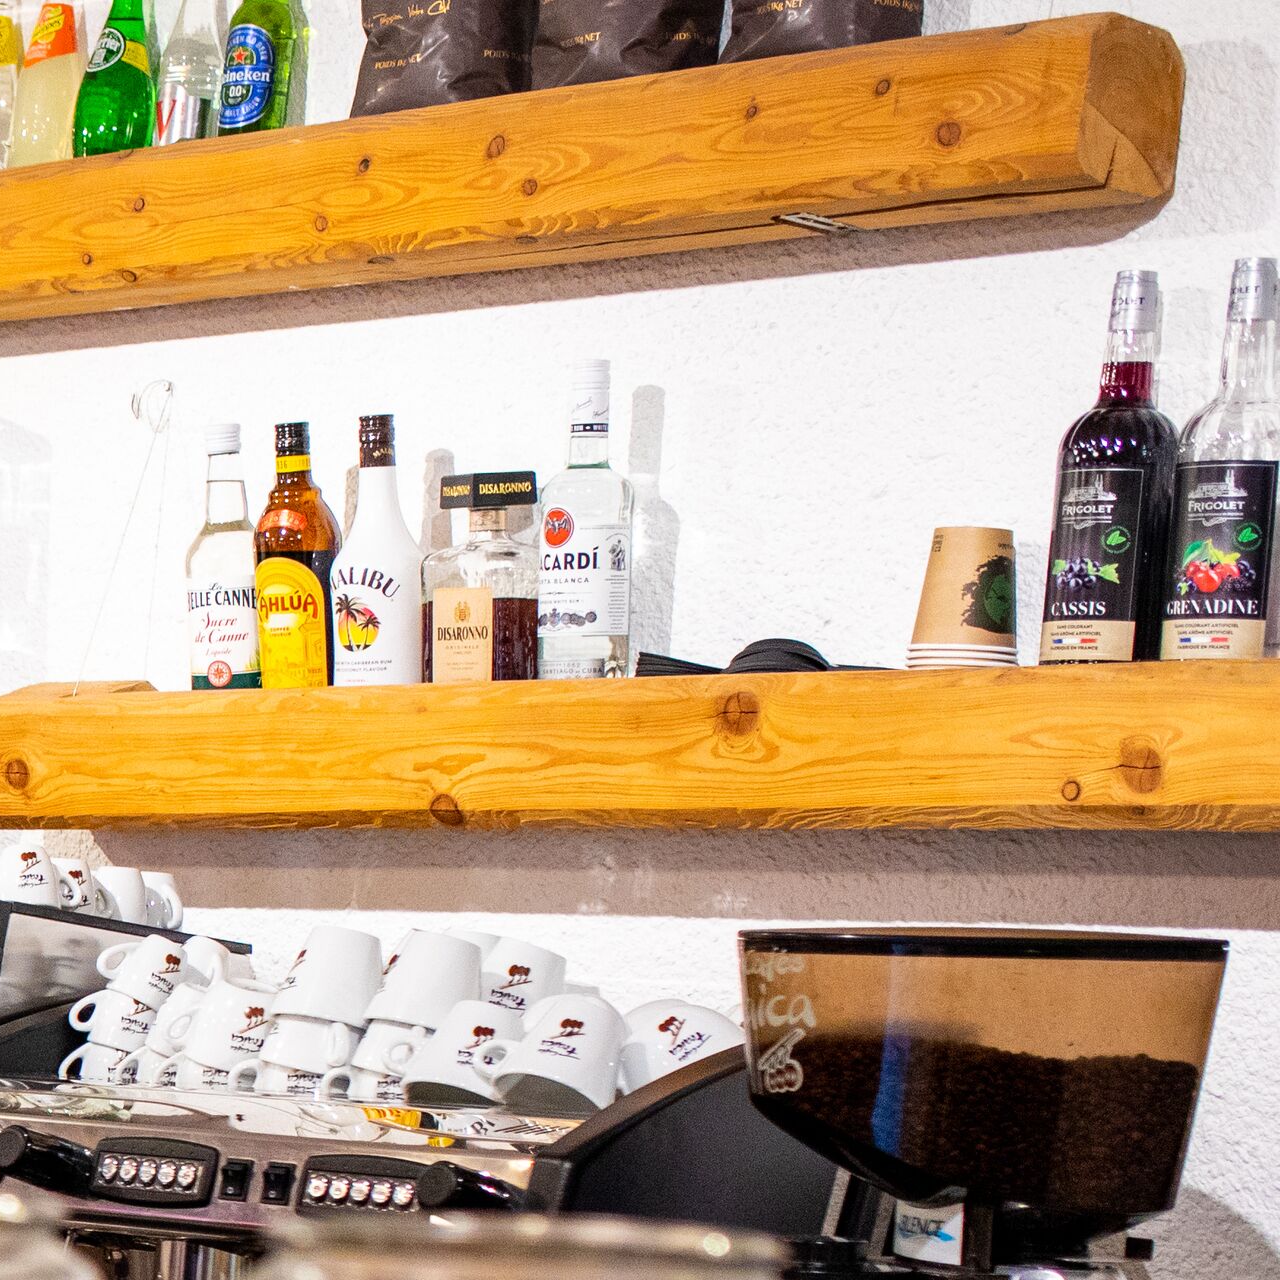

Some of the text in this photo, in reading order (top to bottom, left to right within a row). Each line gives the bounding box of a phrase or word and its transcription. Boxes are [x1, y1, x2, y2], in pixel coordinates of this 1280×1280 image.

[479, 481, 532, 495] DISARONNO
[1062, 504, 1114, 517] FRIGOLET
[1188, 501, 1246, 513] FRIGOLET
[215, 588, 256, 610] CANNE
[1051, 601, 1106, 618] CASSIS
[1166, 599, 1259, 617] GRENADINE
[202, 611, 237, 629] Sucre
[208, 629, 249, 643] Canne
[437, 626, 488, 643] DISARONNO
[581, 667, 602, 675] CUBA
